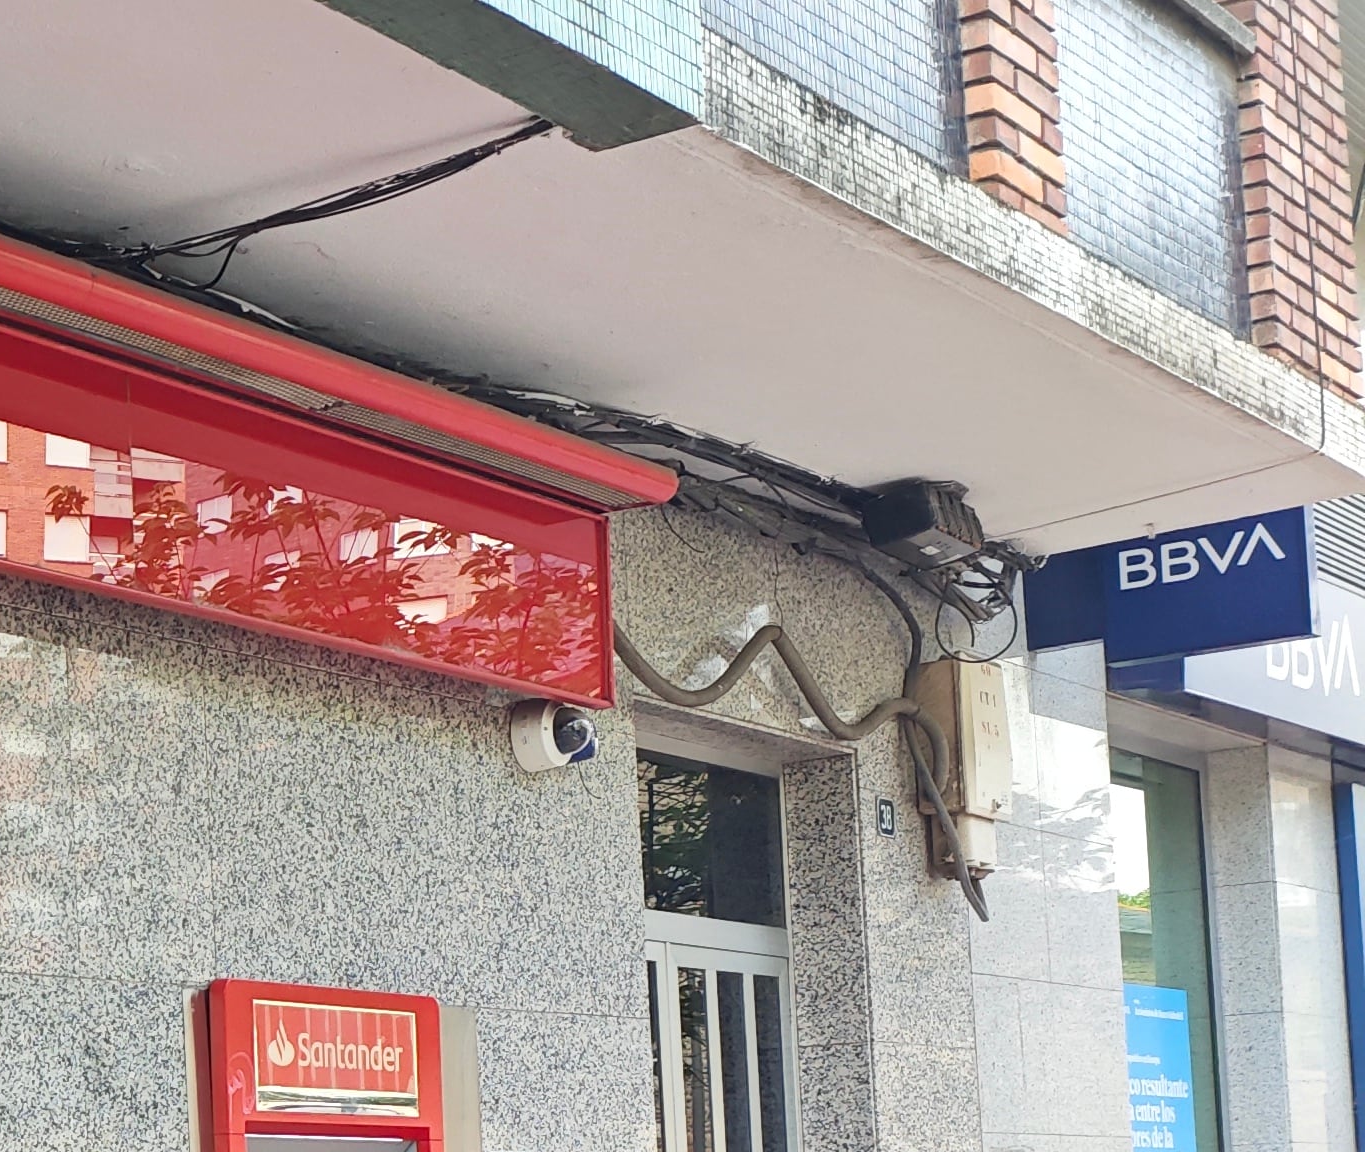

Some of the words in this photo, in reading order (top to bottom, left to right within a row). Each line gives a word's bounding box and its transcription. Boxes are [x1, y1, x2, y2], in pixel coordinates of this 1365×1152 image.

[1118, 522, 1287, 591] BBVA
[880, 805, 893, 829] 38
[297, 1032, 403, 1073] Santander
[1141, 1074, 1189, 1098] resultante
